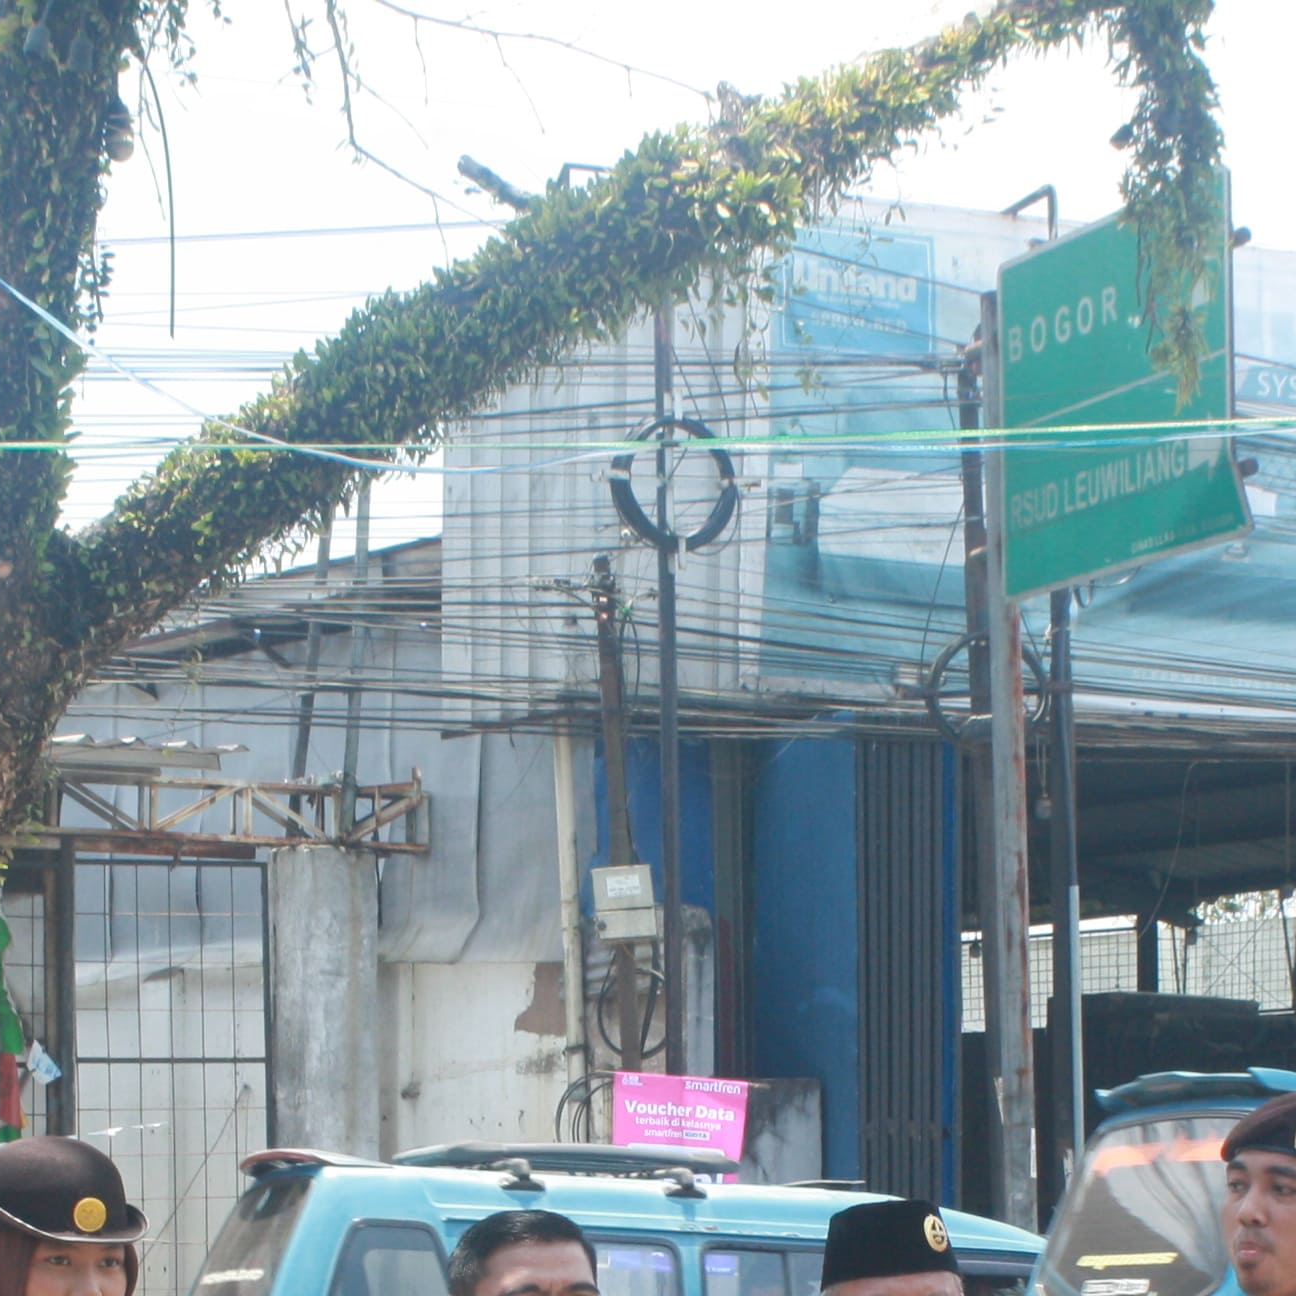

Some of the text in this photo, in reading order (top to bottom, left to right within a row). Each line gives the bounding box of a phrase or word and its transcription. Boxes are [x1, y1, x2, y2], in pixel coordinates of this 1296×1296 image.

[1008, 285, 1118, 364] BOGOR
[1011, 440, 1186, 531] RSUD LEUWILIANG
[684, 1080, 742, 1095] smartfren
[624, 1099, 735, 1121] Voucher Data
[635, 1116, 722, 1132] terbaik di kelasnya
